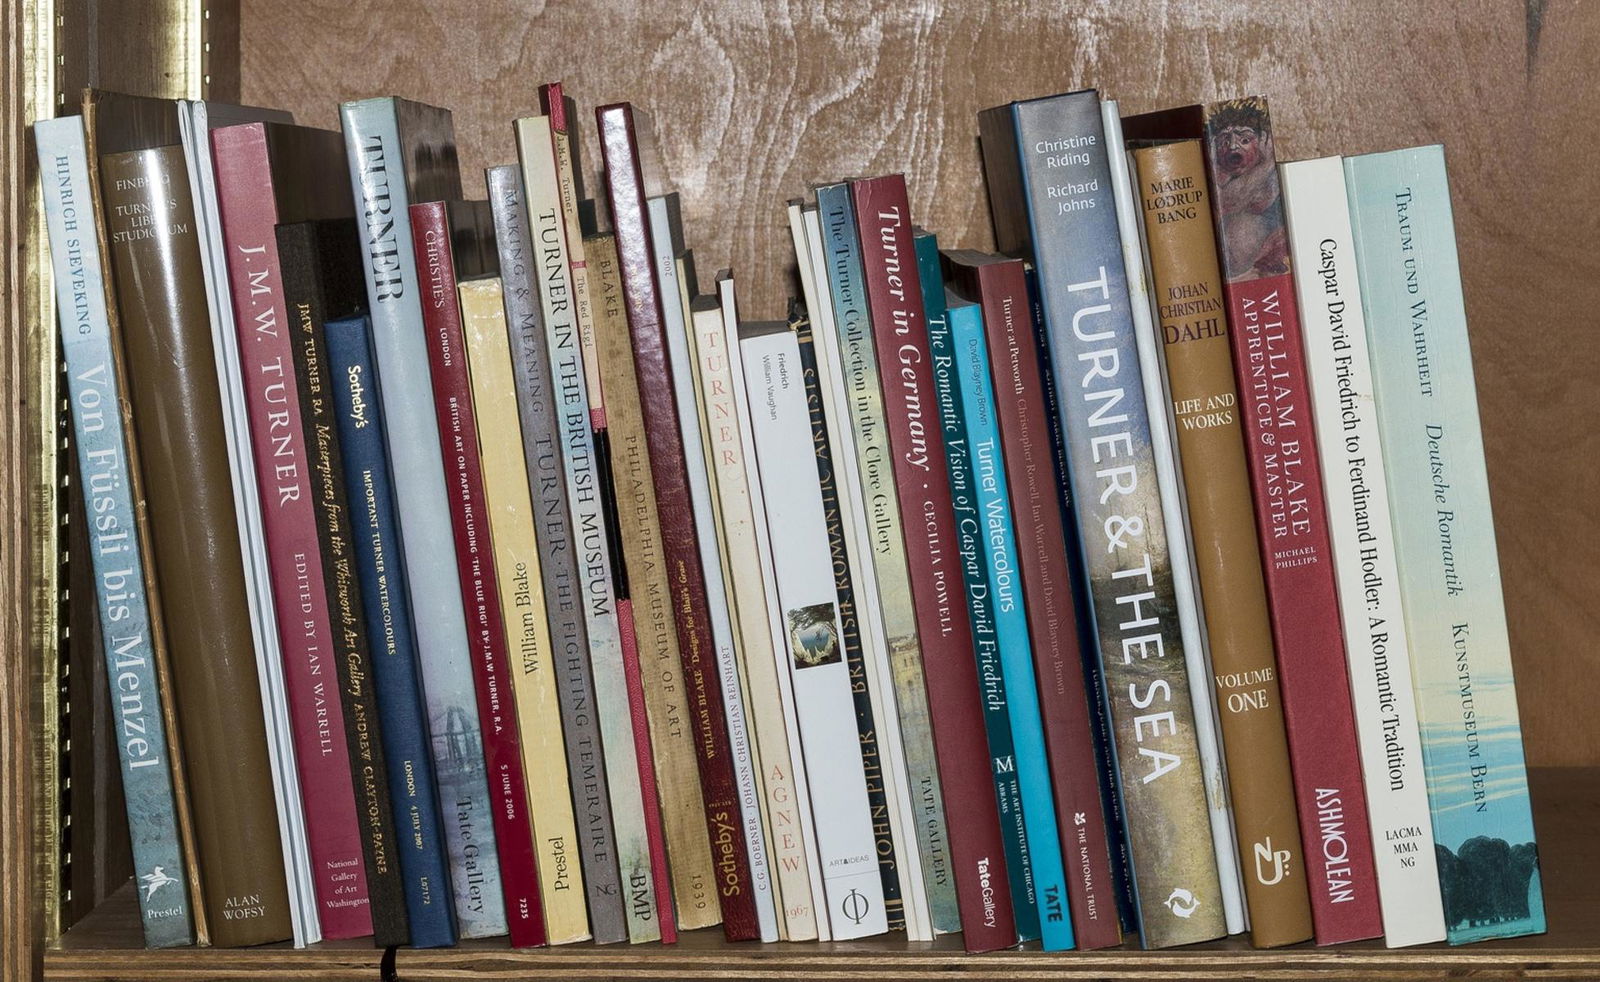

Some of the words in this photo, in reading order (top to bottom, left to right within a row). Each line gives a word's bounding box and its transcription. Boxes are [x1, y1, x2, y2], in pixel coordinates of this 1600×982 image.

[1036, 134, 1096, 154] Christine
[1047, 152, 1090, 168] Riding
[561, 177, 573, 213] Turner
[1048, 179, 1099, 199] Richard
[1058, 198, 1096, 216] Johns
[1147, 191, 1203, 211] LØDRUP
[1150, 176, 1194, 194] MARIE
[359, 135, 404, 304] TURNER
[827, 205, 847, 241] The
[1158, 207, 1197, 224] BANG
[55, 155, 77, 232] HINRICH
[66, 238, 91, 335] SIEVEKING
[538, 209, 568, 316] TURNER
[662, 255, 672, 276] 2002
[877, 205, 911, 302] Turner
[424, 229, 445, 308] CHRISTIE'S
[576, 276, 586, 294] The
[600, 259, 617, 317] BLAKE
[833, 244, 857, 306] Turner
[1317, 238, 1343, 297] Caspar
[515, 286, 529, 301] &
[579, 300, 589, 318] Red
[1160, 297, 1222, 320] CHRISTIAN
[1168, 282, 1208, 301] JOHAN
[296, 302, 312, 335] JMW
[554, 323, 572, 349] IN
[581, 324, 592, 348] Rigi
[892, 308, 916, 335] in
[928, 314, 949, 349] The
[1164, 318, 1224, 344] DAHL
[1327, 300, 1350, 351] David
[303, 338, 320, 394] TURNER
[439, 327, 452, 366] LONDON
[843, 309, 871, 393] Collection
[1002, 295, 1016, 334] Turner
[1009, 346, 1024, 394] Petworth
[1241, 297, 1272, 428] APPRENTICE
[558, 355, 580, 404] THE
[761, 354, 773, 384] William
[776, 352, 789, 389] Friedrich
[1064, 265, 1140, 505] TURNER
[74, 364, 113, 435] Von
[311, 398, 323, 416] RA
[345, 364, 368, 428] Sotheby's
[449, 397, 461, 431] BRITISH
[704, 331, 736, 466] TURNER
[765, 385, 778, 421] Vaughan
[857, 395, 873, 412] in
[895, 343, 931, 473] Germany
[934, 353, 962, 433] Romantic
[1174, 398, 1202, 415] LIFE
[1206, 392, 1234, 411] AND
[1260, 291, 1296, 428] WILLIAM
[1280, 440, 1310, 536] BLAKE
[1334, 355, 1361, 430] Friedrich
[258, 356, 303, 507] TURNER
[860, 415, 877, 441] the
[1182, 410, 1232, 430] WORKS
[1260, 432, 1274, 446] &
[454, 435, 463, 452] ART
[457, 455, 466, 469] ON
[566, 411, 594, 503] BRITISH
[947, 438, 971, 490] Vision
[976, 437, 1000, 494] Turner
[1344, 435, 1361, 453] to
[1425, 423, 1450, 503] Deutsche
[459, 472, 470, 500] PAPER
[864, 445, 885, 489] Clore
[85, 445, 129, 557] Füssli
[362, 469, 378, 528] IMPORTANT
[534, 433, 567, 557] TURNER
[625, 434, 655, 570] PHILADELPHIA
[951, 494, 975, 515] of
[1263, 453, 1287, 538] MASTER
[1347, 457, 1375, 543] Ferdinand
[463, 503, 477, 553] INCLUDING
[868, 493, 895, 556] Gallery
[1102, 511, 1147, 553] &
[371, 531, 385, 573] TURNER
[579, 511, 610, 618] MUSEUM
[923, 500, 942, 564] CECILIA
[933, 570, 952, 637] POWELL
[957, 517, 984, 578] Caspar
[985, 497, 1019, 613] Watercolours
[1275, 546, 1316, 560] MICHAEL
[1276, 556, 1318, 570] PHILLIPS
[1437, 509, 1463, 597] Romantik
[102, 567, 138, 622] bis
[294, 552, 312, 613] EDITED
[474, 579, 484, 602] BLUE
[513, 562, 530, 606] Blake
[554, 570, 572, 611] THE
[1359, 548, 1384, 610] Hodler:
[377, 574, 396, 655] WATERCOLOURS
[647, 582, 669, 660] MUSEUM
[969, 582, 992, 633] David
[1109, 554, 1164, 665] THE
[1368, 615, 1386, 629] A
[303, 620, 316, 640] BY
[518, 611, 539, 674] William
[307, 645, 321, 676] IAN
[562, 621, 589, 727] FIGHTING
[661, 671, 674, 692] OF
[720, 645, 736, 700] REINHART
[977, 638, 1005, 710] Friedrich
[1216, 668, 1274, 688] VOLUME
[1370, 631, 1397, 712] Romantic
[111, 632, 159, 770] Menzel
[487, 675, 499, 713] TURNER,
[693, 669, 706, 705] BLAKE
[1228, 689, 1269, 713] ONE
[312, 682, 332, 756] WARRELL
[666, 702, 681, 739] ART
[699, 709, 715, 758] WILLIAM
[730, 704, 746, 762] CHRISTIAN
[1128, 677, 1183, 784] SEA
[1381, 714, 1408, 791] Tradition
[404, 760, 415, 796] LONDON
[500, 772, 511, 795] JUNE
[577, 736, 608, 863] TEMERAIRE
[739, 765, 755, 809] JOHANN
[919, 776, 934, 815] TATE
[455, 796, 474, 840] Tate
[504, 798, 514, 819] 2006
[771, 764, 800, 874] AGNEW
[711, 812, 740, 896] Sotheby's
[748, 816, 763, 866] BOERNER
[870, 804, 895, 871] JOHN
[926, 819, 946, 886] GALLERY
[1077, 827, 1086, 843] THE
[1315, 788, 1355, 904] ASHMOLEAN
[1386, 826, 1422, 841] LACMA
[1394, 842, 1418, 854] MMA
[327, 858, 358, 870] National
[331, 872, 357, 882] Gallery
[462, 843, 486, 915] Gallery
[548, 836, 569, 891] Prestel
[829, 855, 870, 868] ART&IDEAS
[1080, 846, 1092, 891] NATIONAL
[1400, 856, 1416, 868] NG
[225, 894, 260, 908] ALAN
[326, 897, 370, 908] Washington
[630, 874, 652, 921] BMP
[692, 874, 706, 910] 1939
[1023, 867, 1035, 903] CHICAGO
[1044, 884, 1064, 923] TATE
[1086, 894, 1097, 920] TRUST
[147, 906, 182, 918] Prestel
[224, 906, 265, 920] WOFSY
[518, 897, 528, 919] 7235
